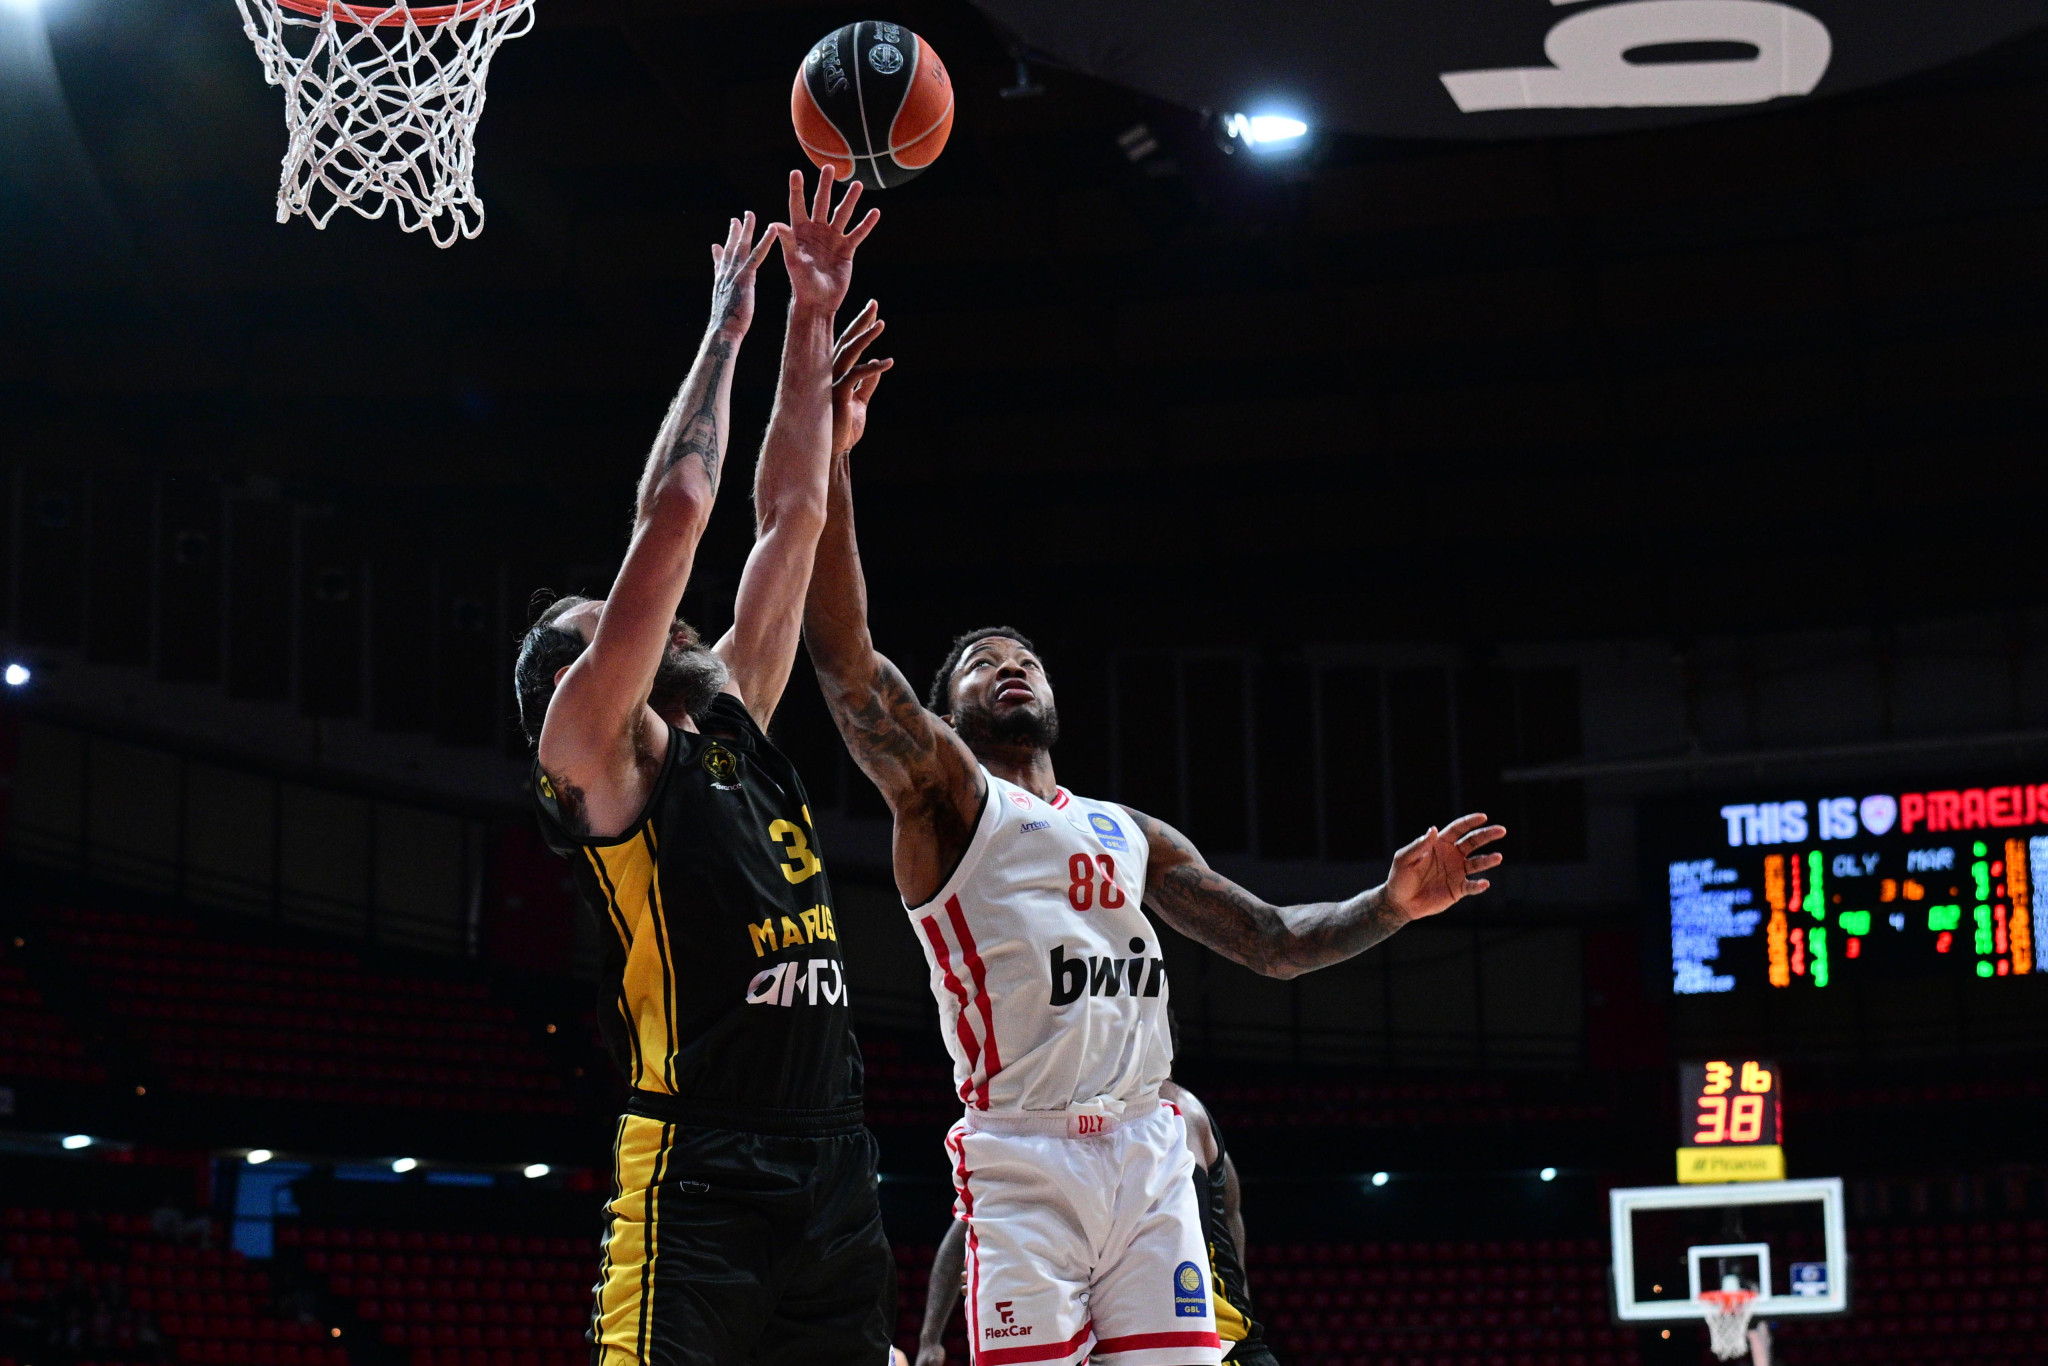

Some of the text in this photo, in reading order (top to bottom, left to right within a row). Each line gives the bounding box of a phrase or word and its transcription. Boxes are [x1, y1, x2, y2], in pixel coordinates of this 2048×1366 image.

[1720, 800, 1808, 847] THIS
[1818, 796, 1858, 840] IS
[1832, 847, 1955, 878] OLY MAR
[1184, 1305, 1201, 1313] GBL
[985, 1325, 1033, 1340] FlexCar
